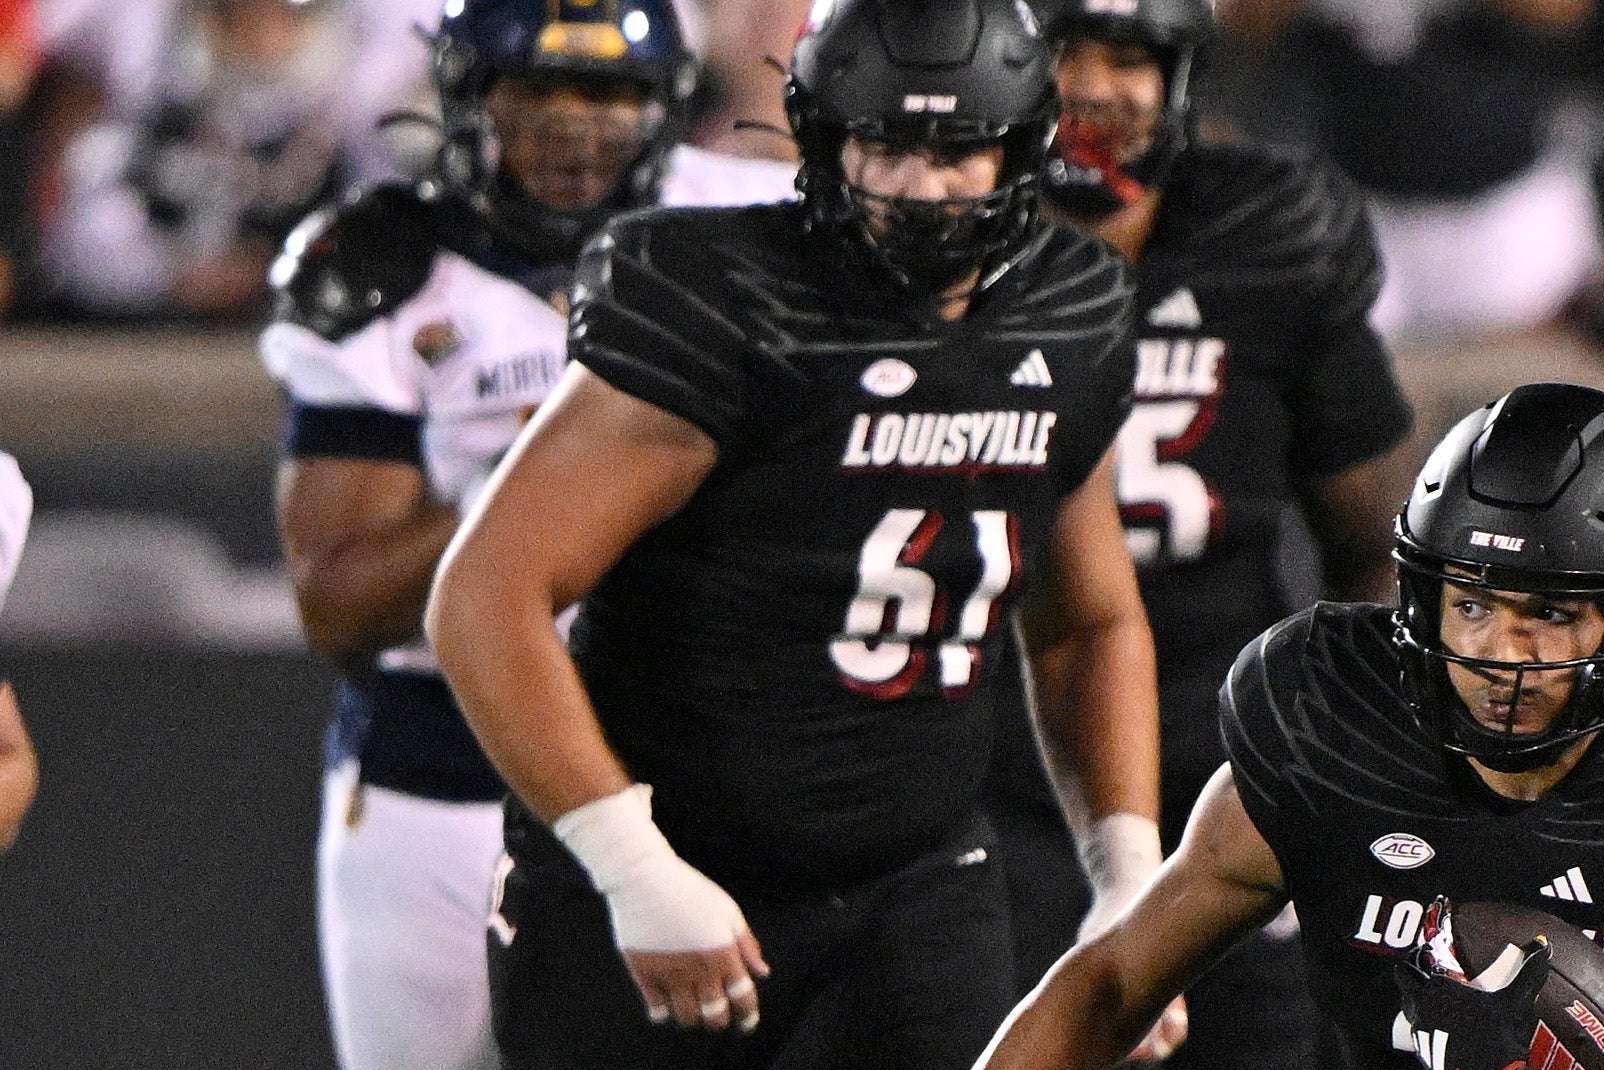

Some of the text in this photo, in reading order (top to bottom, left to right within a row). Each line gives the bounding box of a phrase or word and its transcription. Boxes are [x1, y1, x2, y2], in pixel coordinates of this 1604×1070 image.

[840, 411, 1058, 468] LOUISVILLE
[1470, 530, 1526, 552] THE VILLE
[829, 508, 1018, 693] 61
[1382, 842, 1424, 857] ACC
